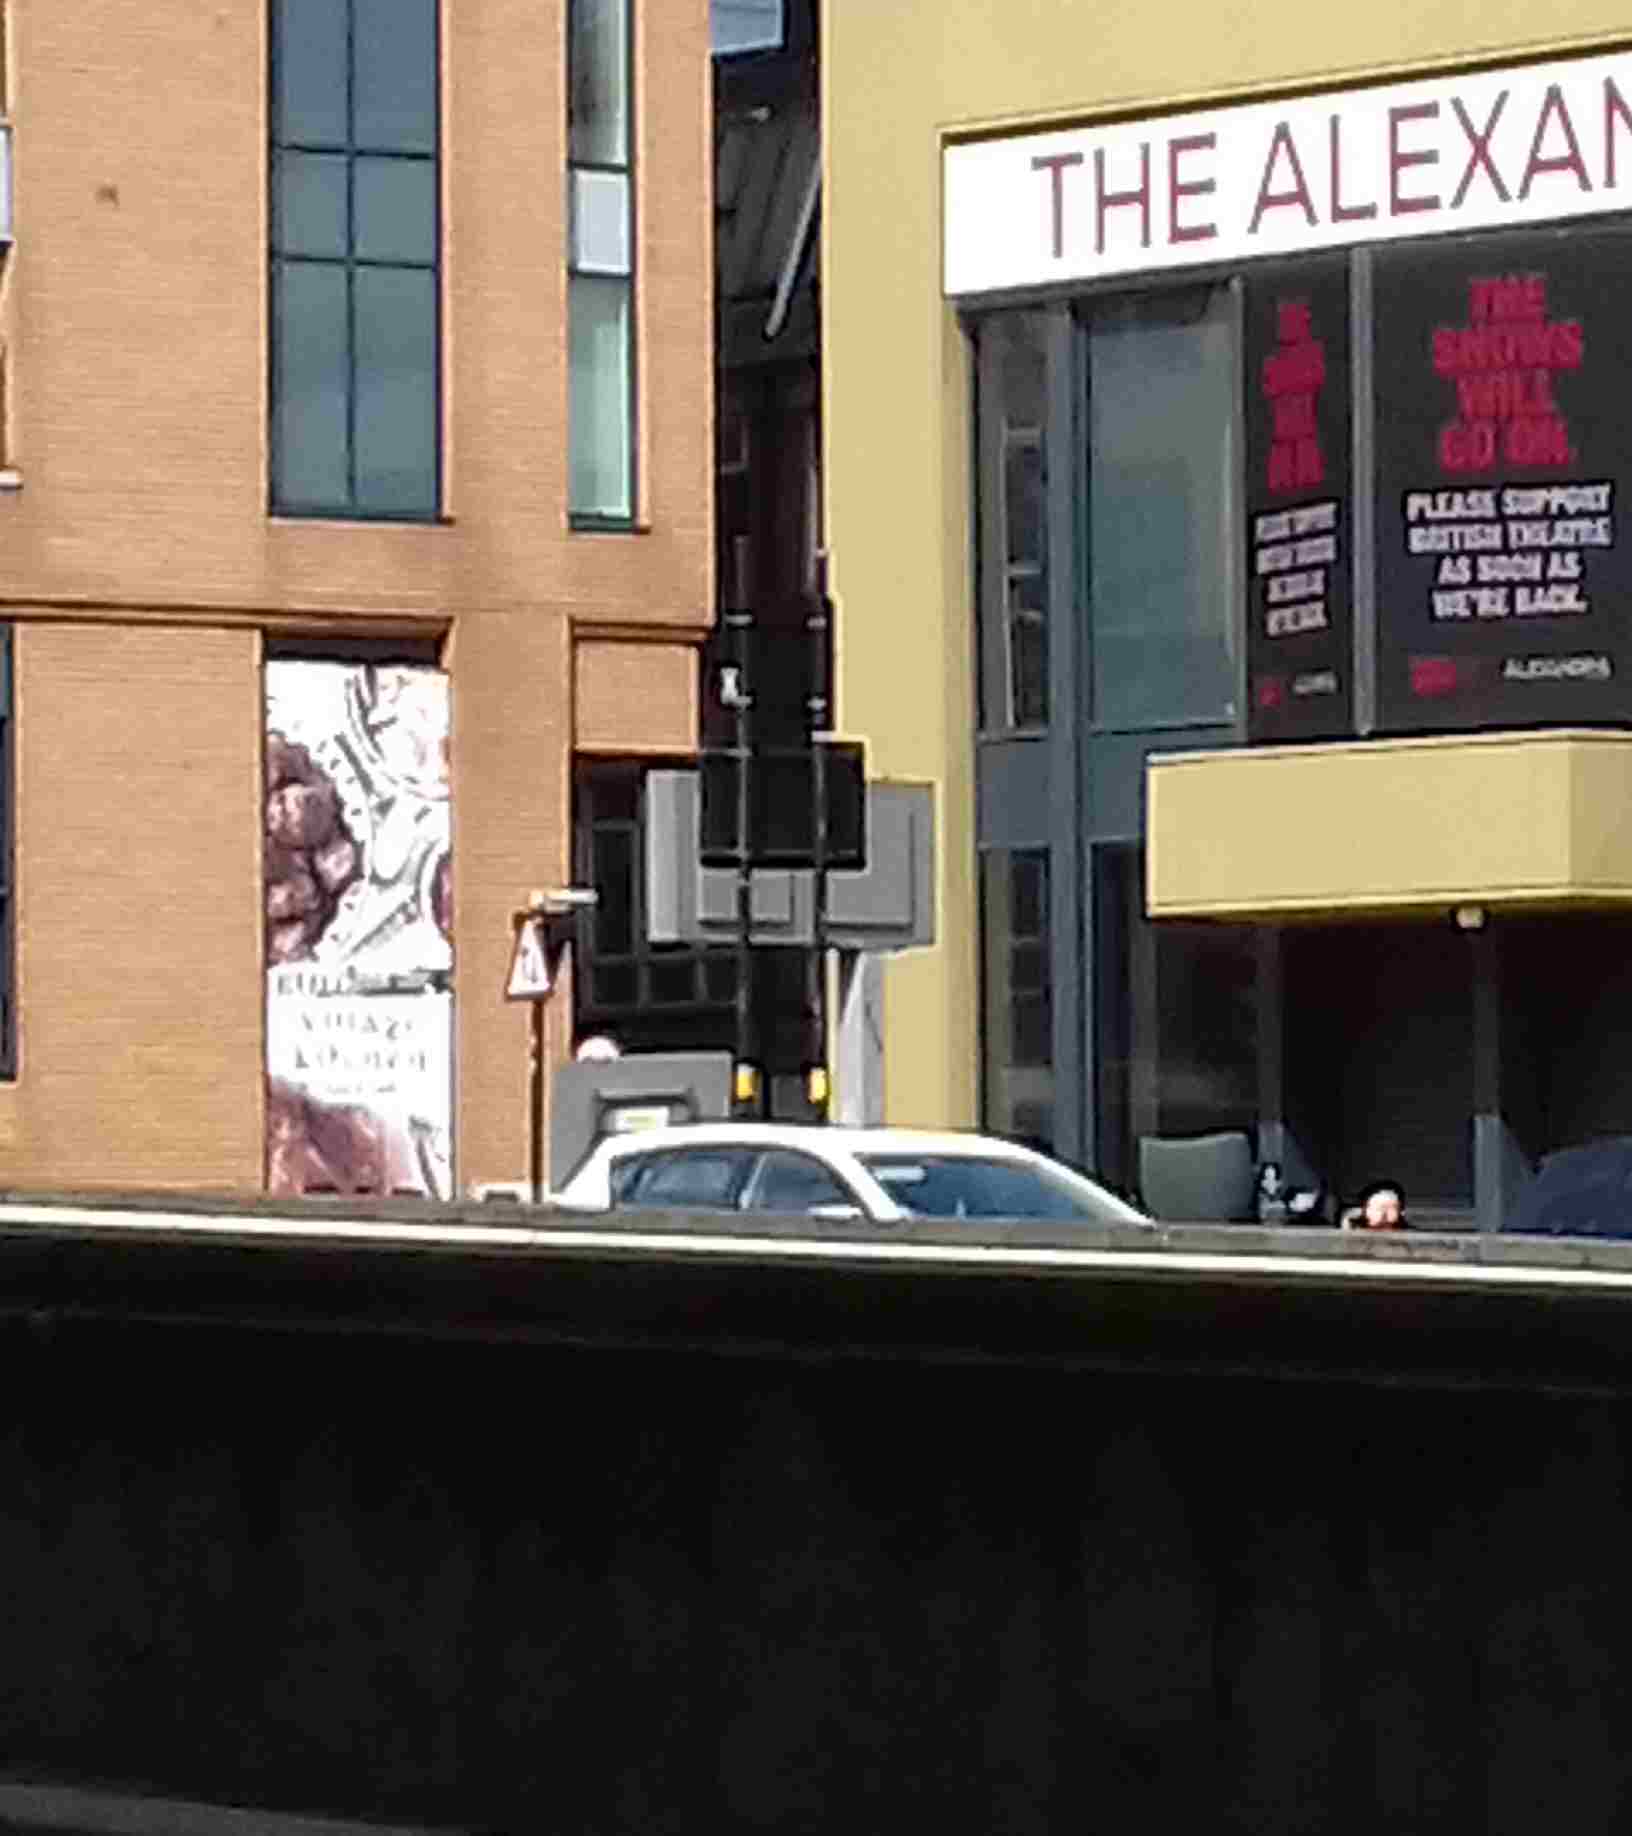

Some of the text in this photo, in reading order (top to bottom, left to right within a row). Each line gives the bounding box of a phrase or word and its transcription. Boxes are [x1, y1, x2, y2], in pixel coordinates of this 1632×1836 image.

[1030, 133, 1220, 259] THE
[1468, 273, 1546, 320] THE
[1432, 320, 1584, 372] SHOWS
[1457, 368, 1559, 418] WILL
[1440, 424, 1497, 473] GO
[1406, 483, 1611, 522] PLEASE SUPPORT
[1408, 516, 1612, 553] BRITISH THEATRE
[1438, 551, 1583, 584] AS SOON AS
[1431, 586, 1510, 618] WE'RE
